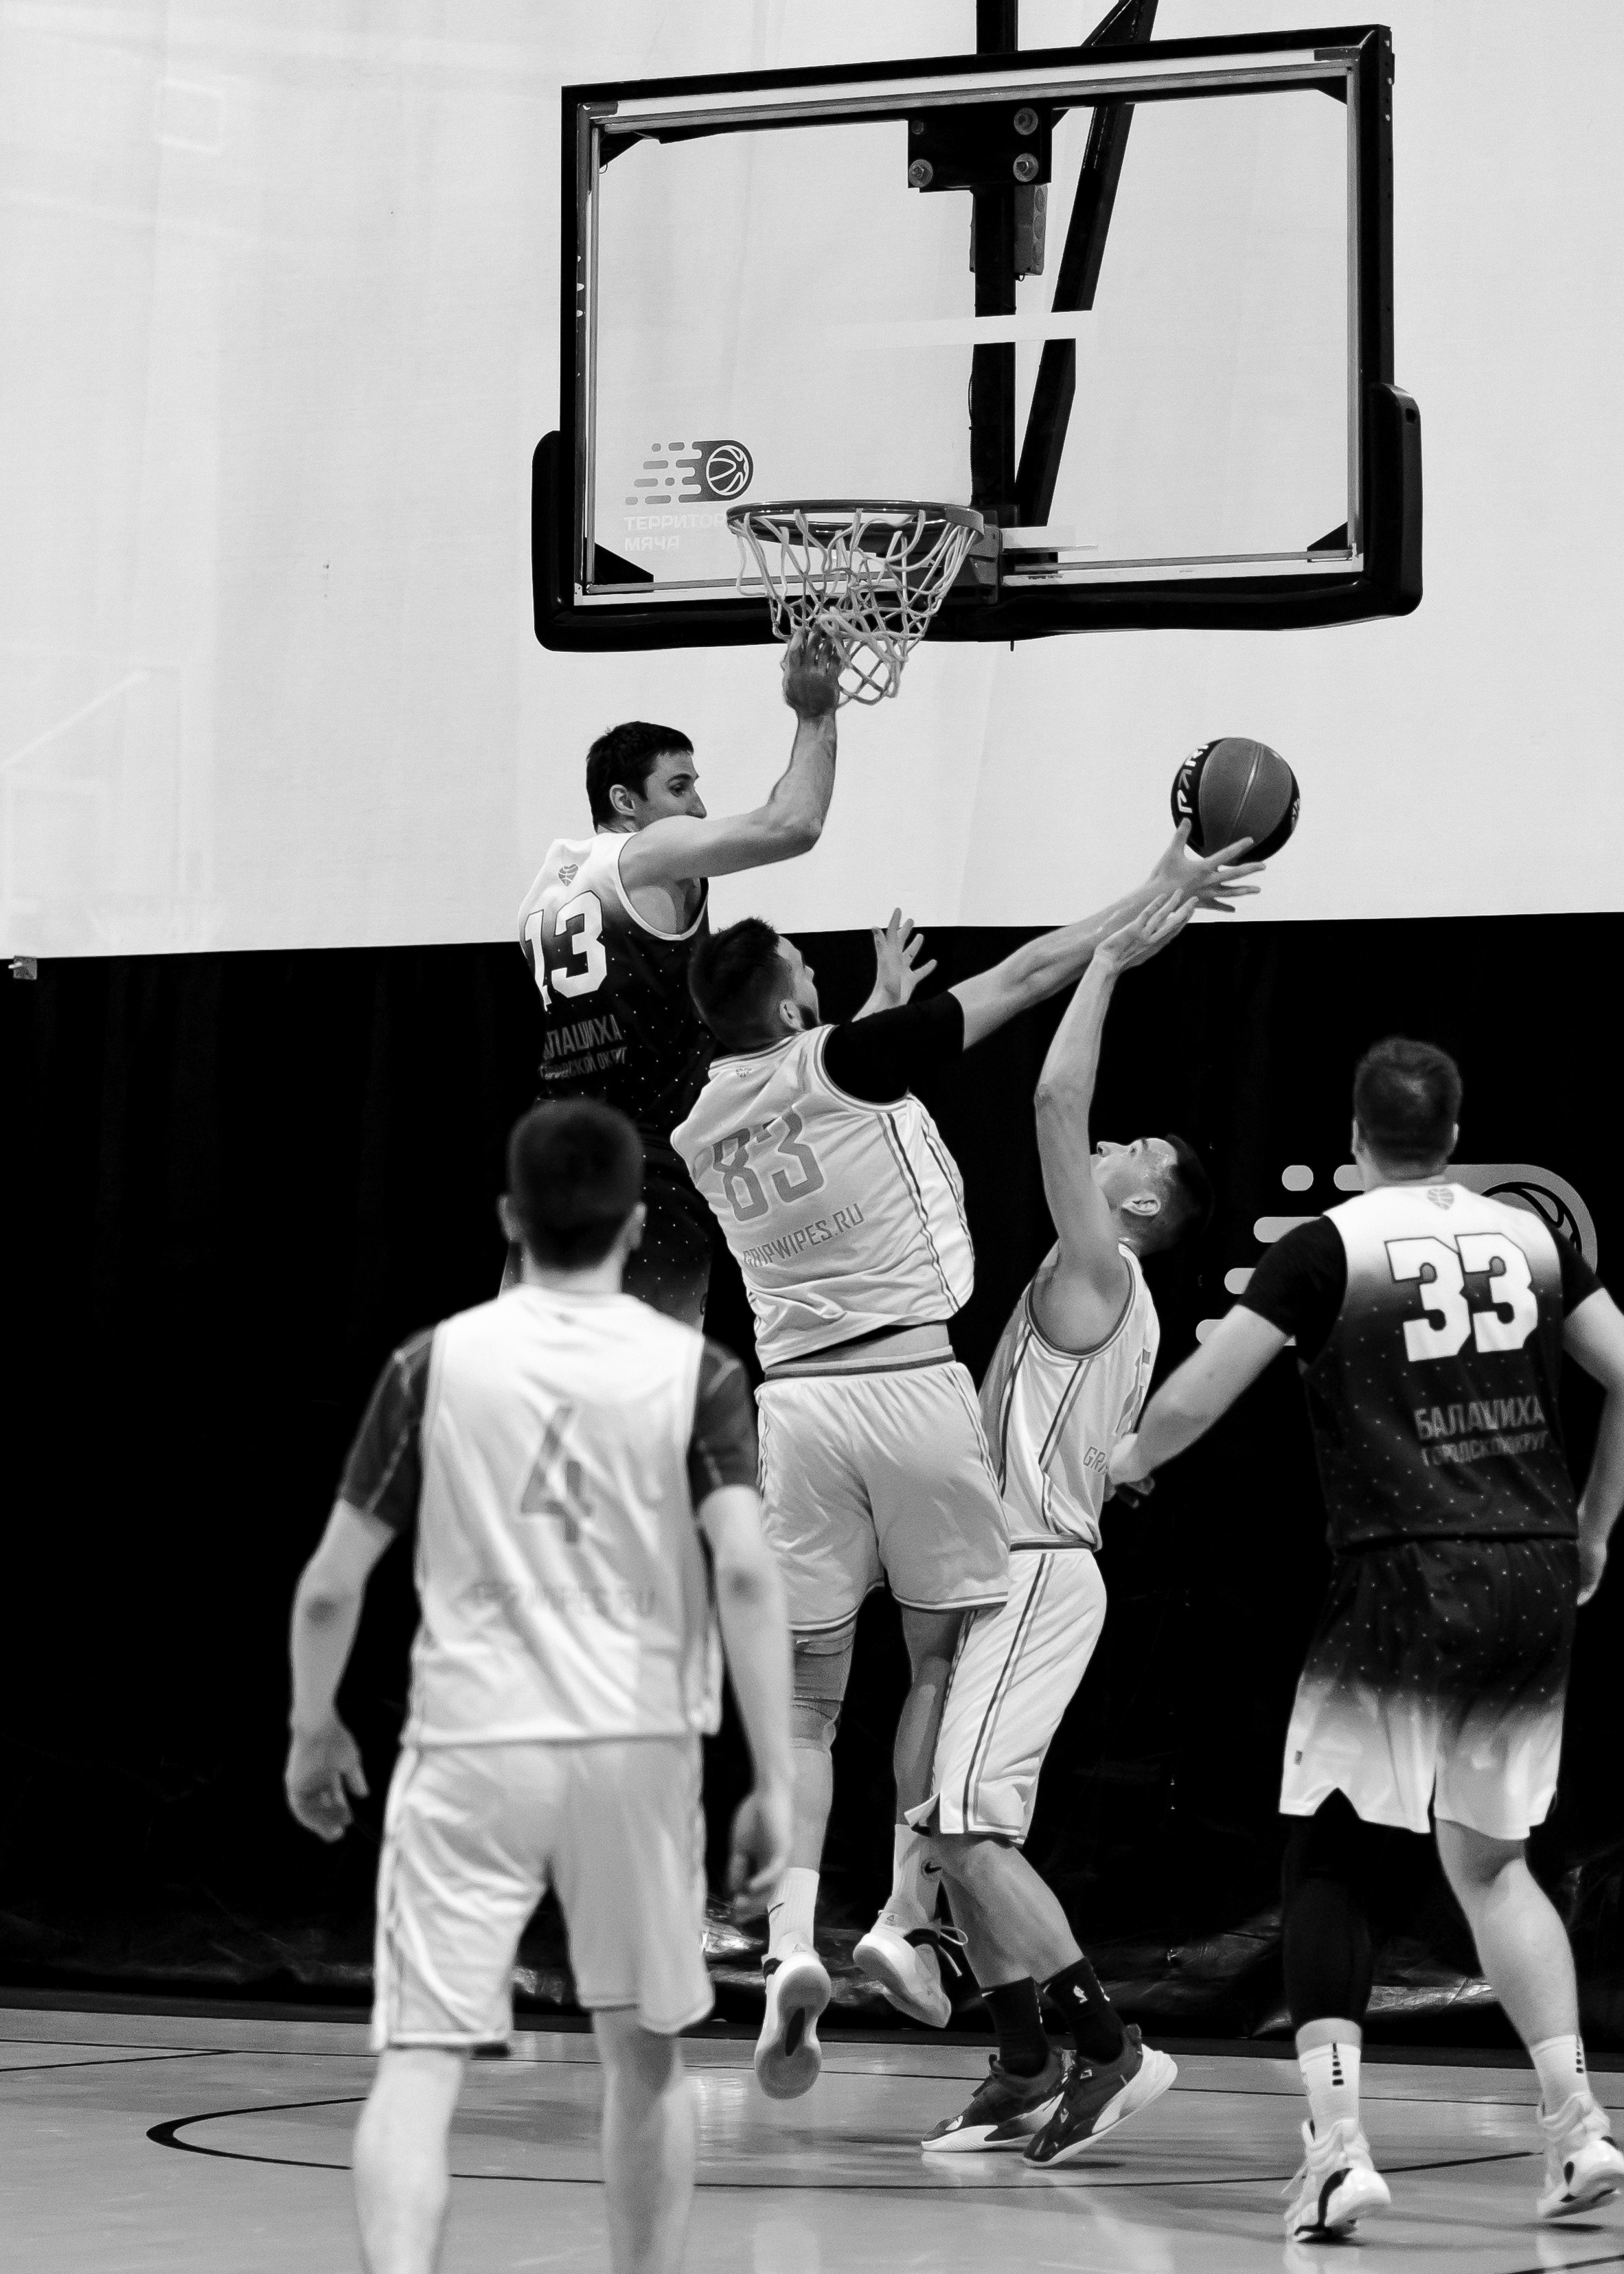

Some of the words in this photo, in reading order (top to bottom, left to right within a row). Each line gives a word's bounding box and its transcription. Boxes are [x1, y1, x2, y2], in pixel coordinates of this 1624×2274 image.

[624, 514, 726, 530] ТЕРРИТОР
[624, 534, 681, 552] МЯЧА
[524, 889, 607, 1012] 13
[712, 1109, 824, 1222] 83
[742, 1203, 865, 1268] GRIPWIPES.RU
[1384, 1232, 1538, 1362] 33
[520, 1405, 593, 1545] 4
